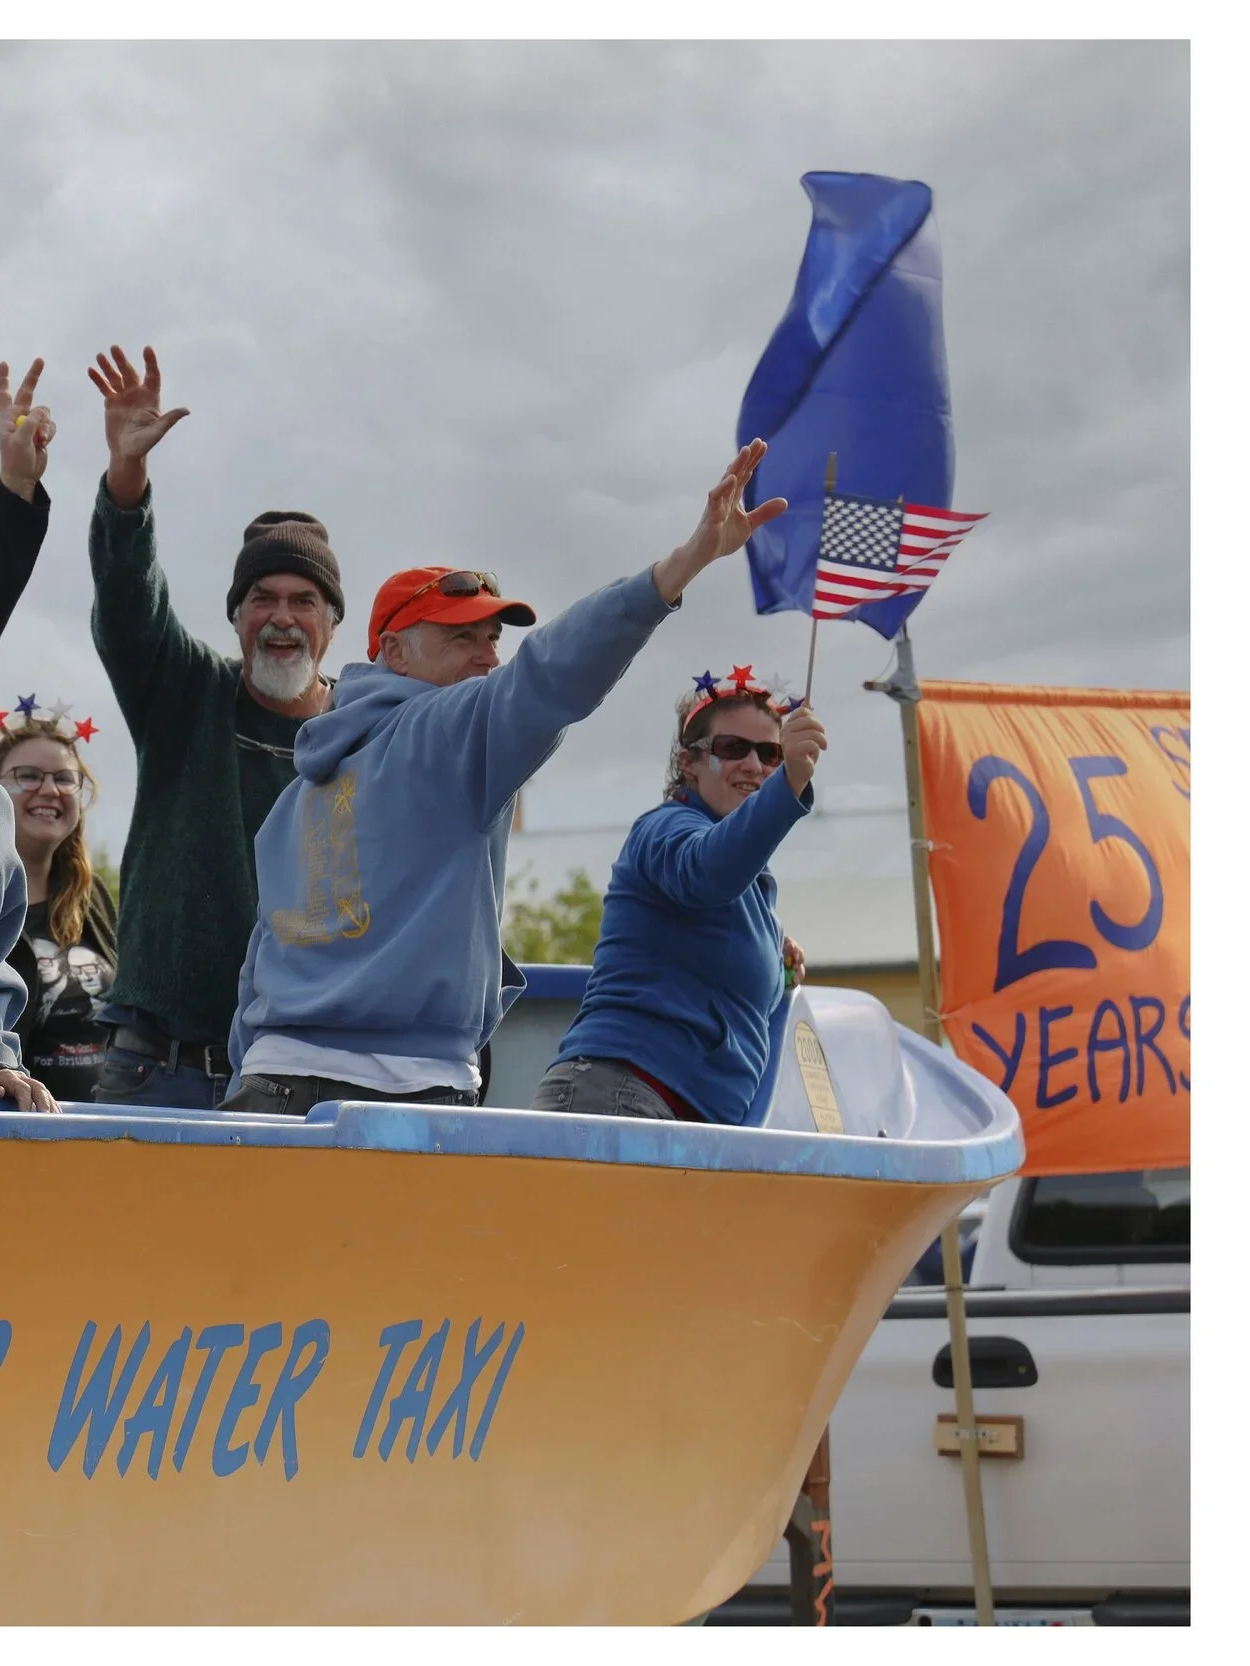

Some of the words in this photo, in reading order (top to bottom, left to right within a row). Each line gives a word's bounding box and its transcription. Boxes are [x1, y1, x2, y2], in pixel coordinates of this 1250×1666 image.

[967, 755, 1163, 993] 25
[34, 1056, 54, 1067] For
[58, 1054, 92, 1067] British
[47, 1319, 332, 1482] WATER
[353, 1316, 526, 1465] TAXI
